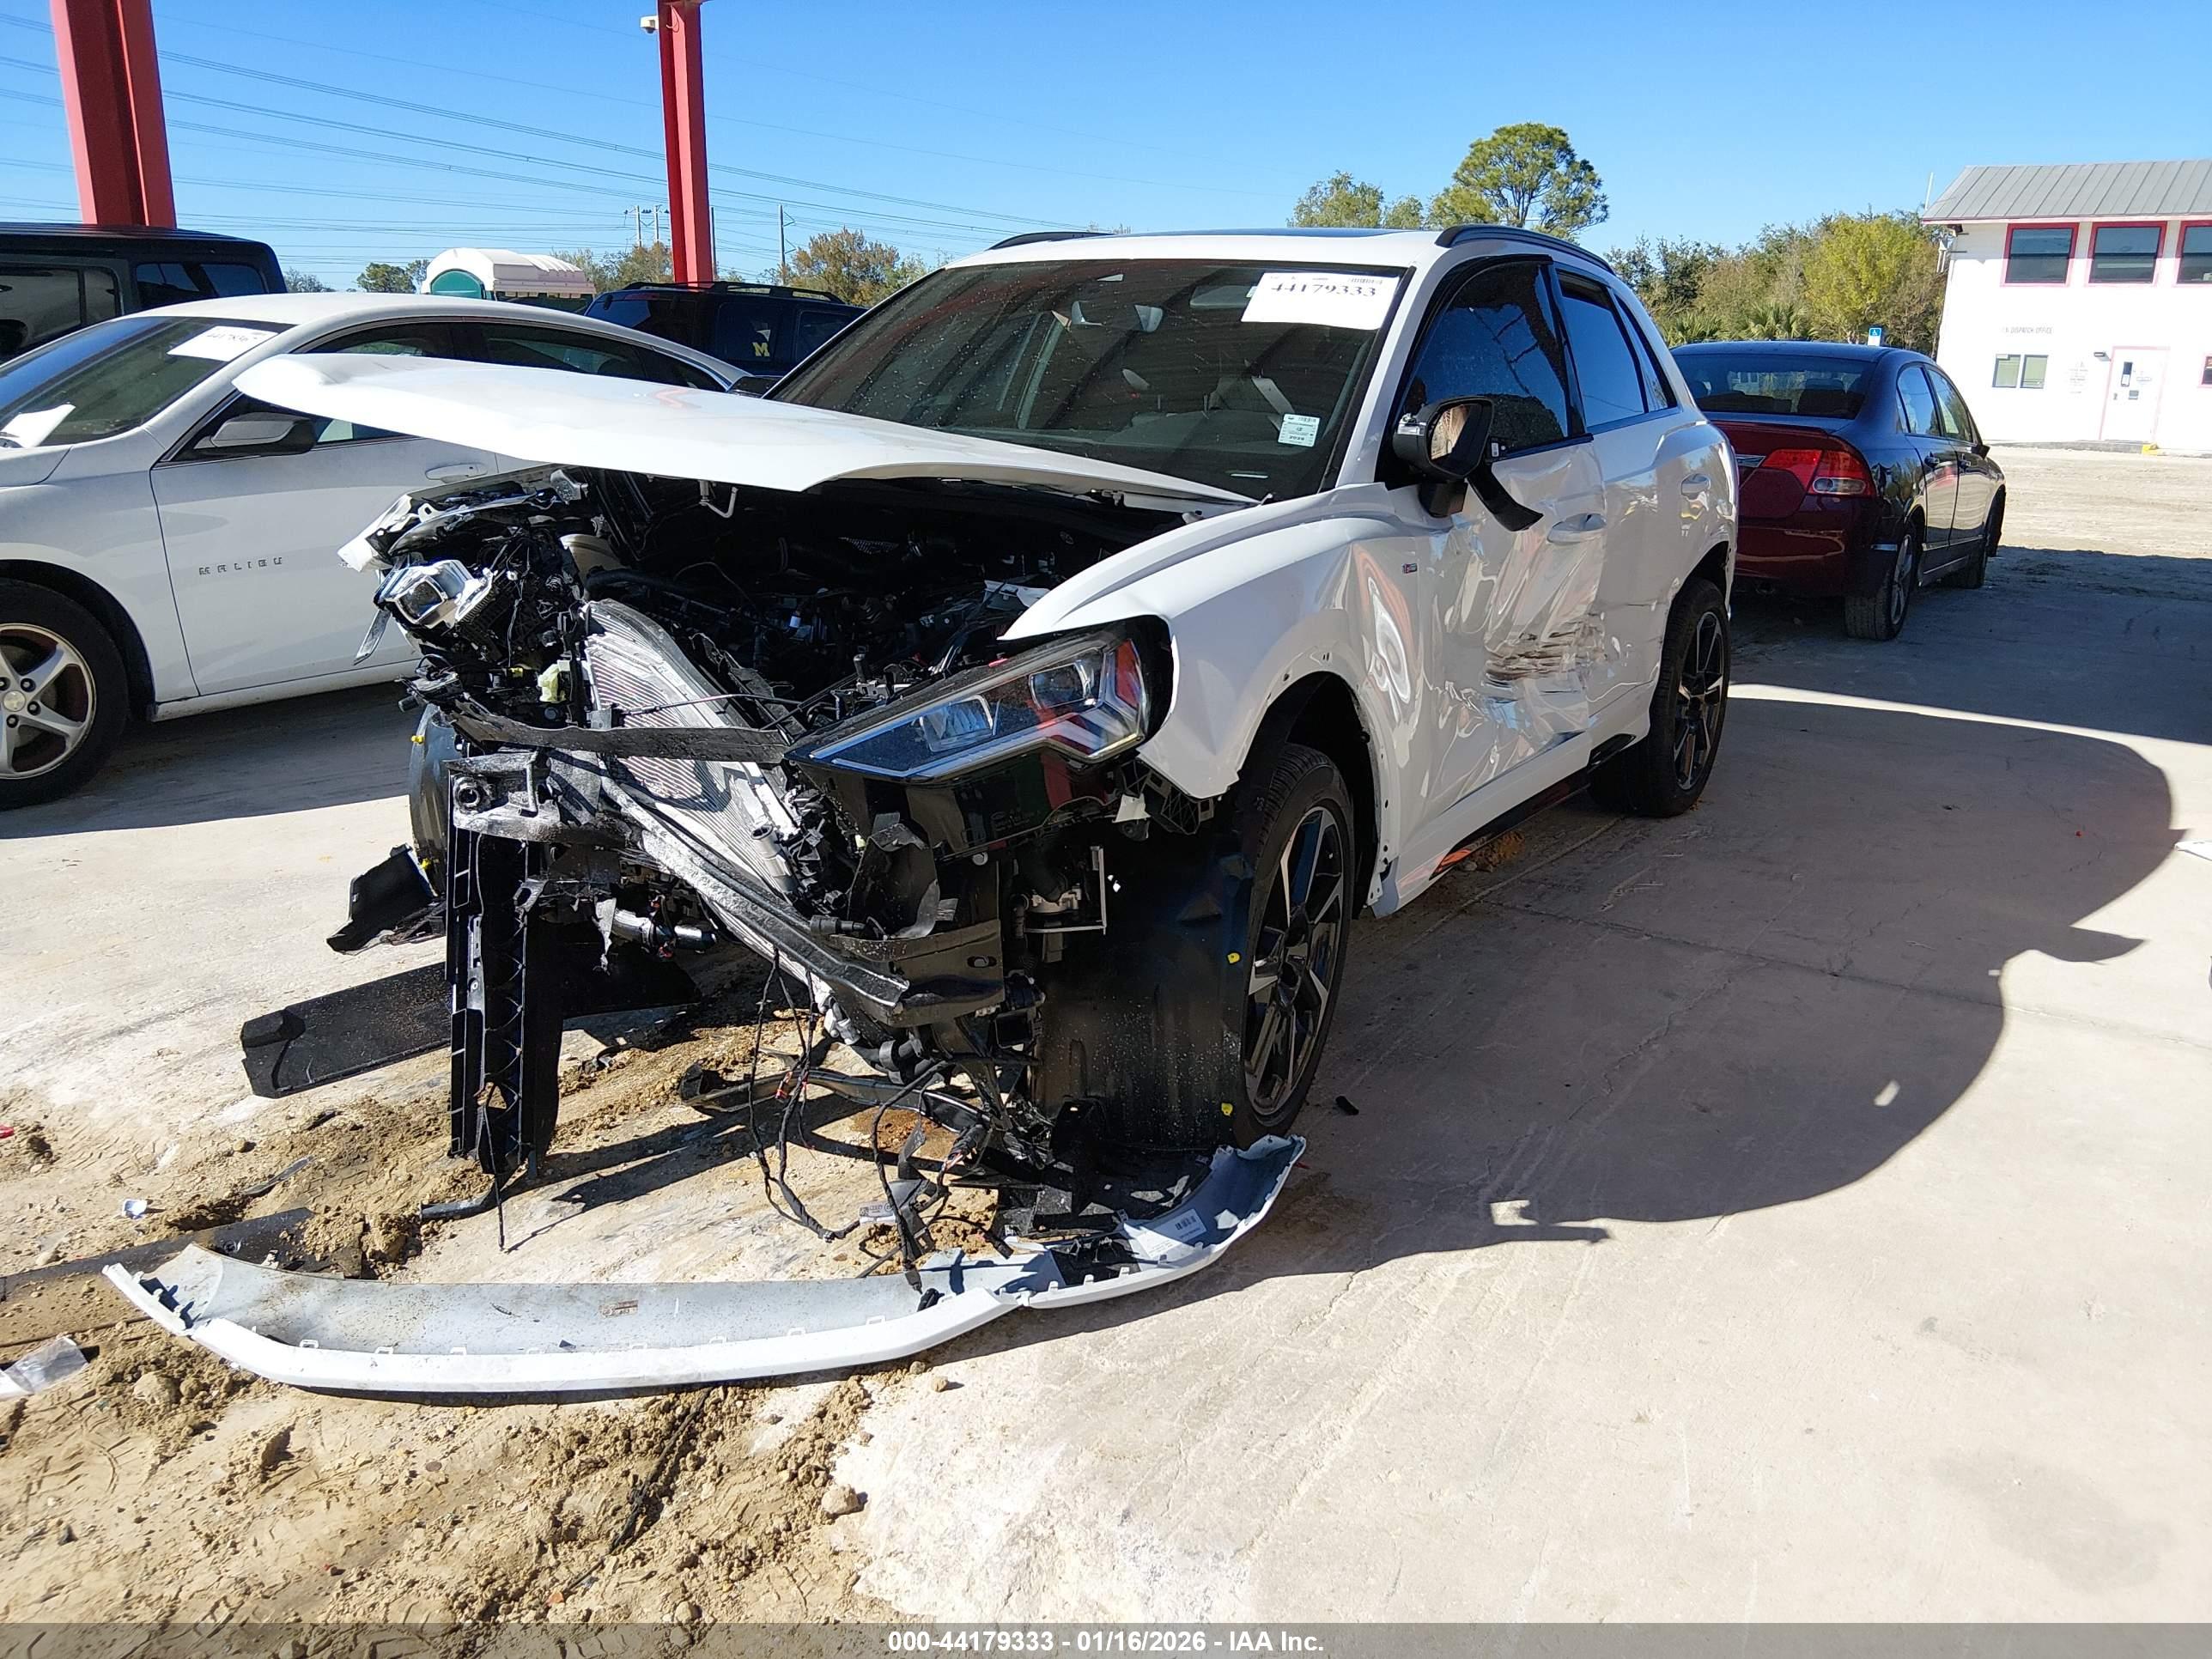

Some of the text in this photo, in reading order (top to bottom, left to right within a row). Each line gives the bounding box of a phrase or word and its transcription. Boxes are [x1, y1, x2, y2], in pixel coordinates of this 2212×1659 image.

[1271, 283, 1376, 297] 44179333
[751, 342, 770, 357] M
[198, 556, 283, 575] MALIBU
